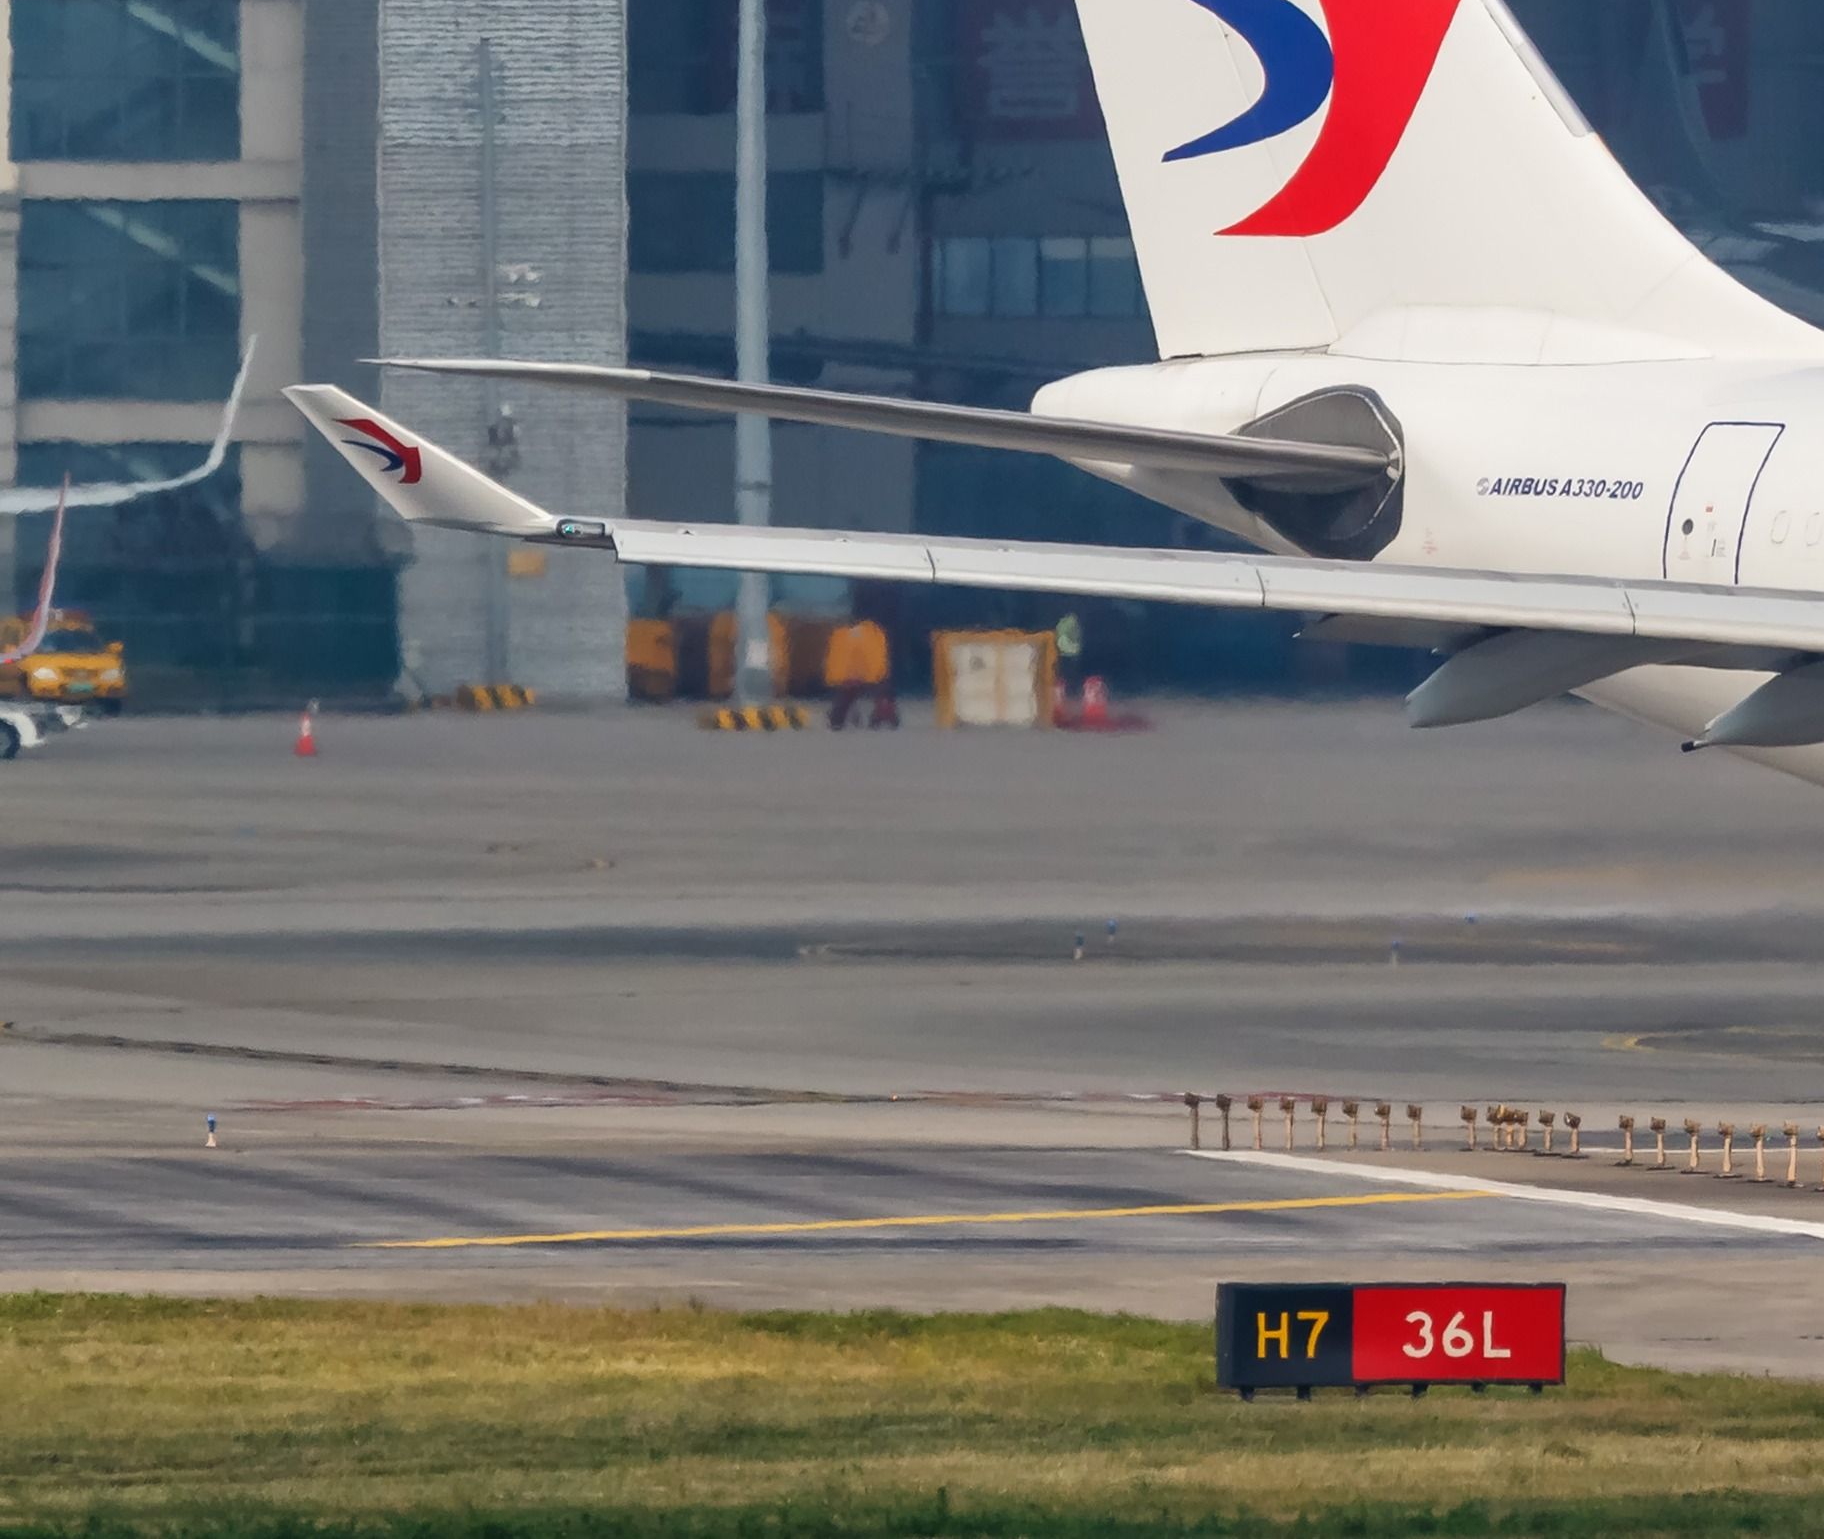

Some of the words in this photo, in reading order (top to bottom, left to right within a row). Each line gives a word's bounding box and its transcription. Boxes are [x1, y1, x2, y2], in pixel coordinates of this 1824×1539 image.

[1488, 476, 1560, 497] AIRBUS
[1558, 478, 1645, 501] A330-200
[1256, 1310, 1330, 1360] H7
[1402, 1309, 1512, 1360] 36L
